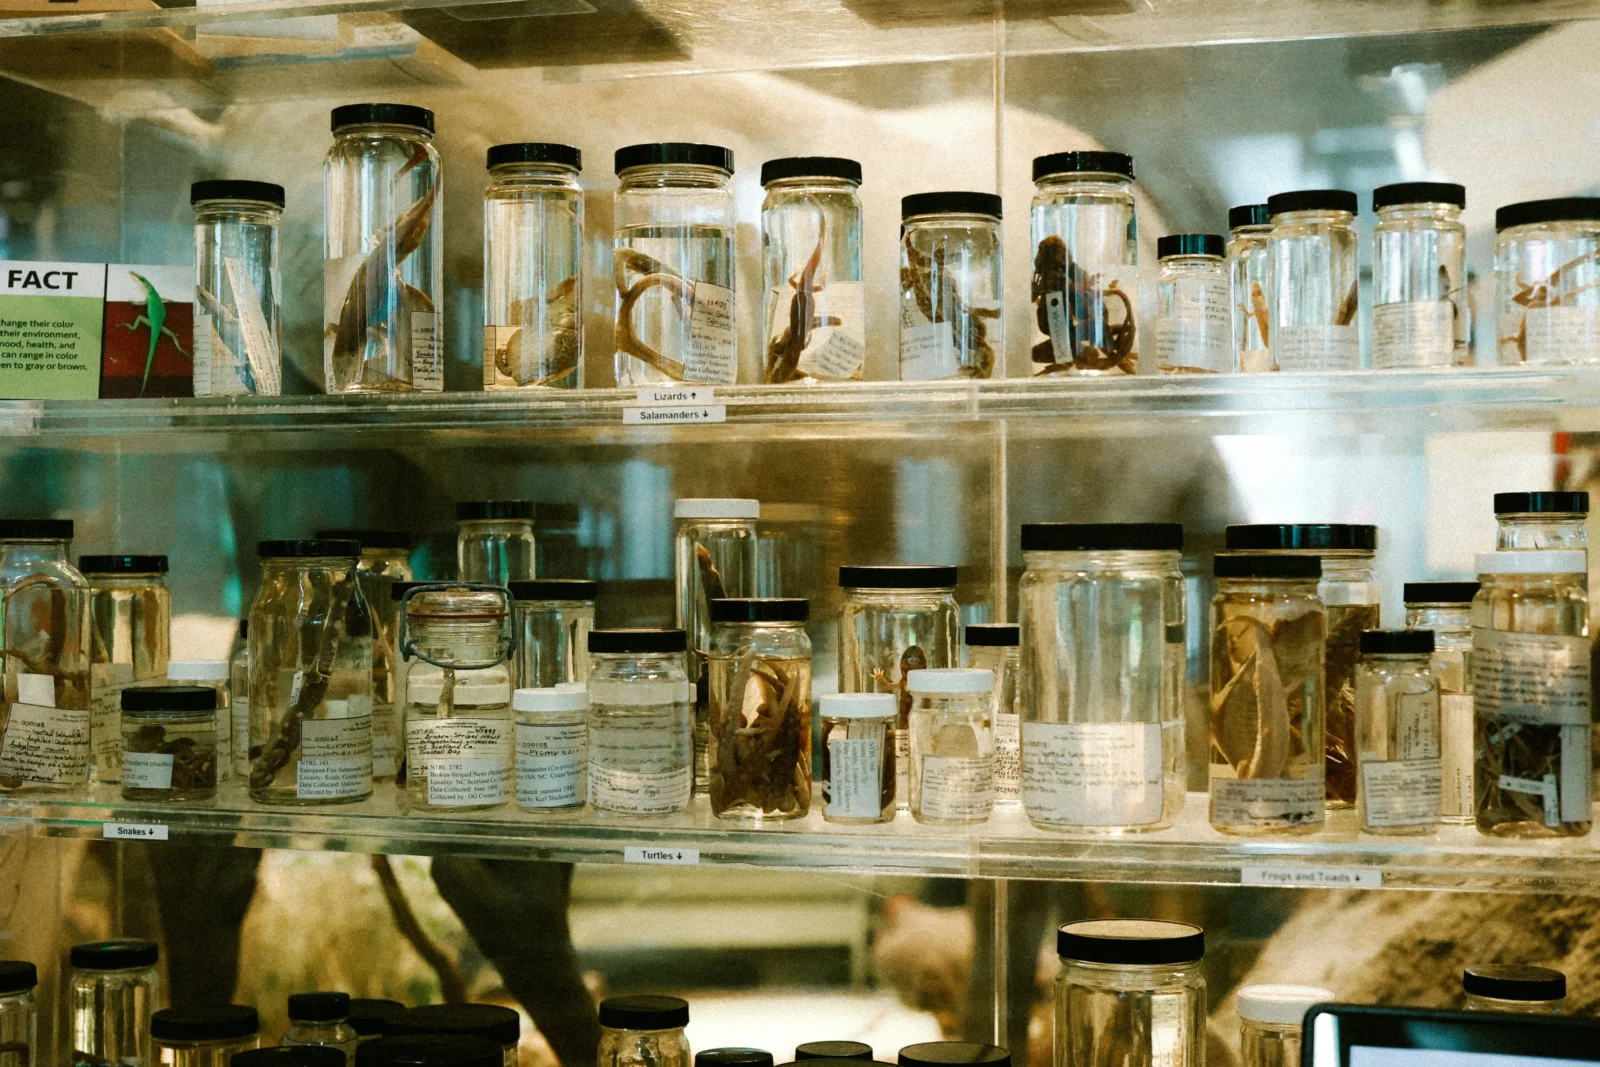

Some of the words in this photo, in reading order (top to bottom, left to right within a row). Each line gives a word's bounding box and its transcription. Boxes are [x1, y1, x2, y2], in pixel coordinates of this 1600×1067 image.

[8, 270, 79, 290] FACT
[30, 320, 50, 328] their
[22, 331, 81, 340] environment,
[26, 341, 57, 350] health,
[56, 352, 79, 360] color
[25, 363, 45, 371] gray
[57, 363, 88, 371] brown.
[654, 392, 688, 401] Lizards
[640, 411, 699, 420] Salamanders
[117, 826, 146, 836] Snakes
[642, 850, 674, 860] Turtles
[1261, 871, 1292, 882] Frogs
[1296, 871, 1315, 881] and
